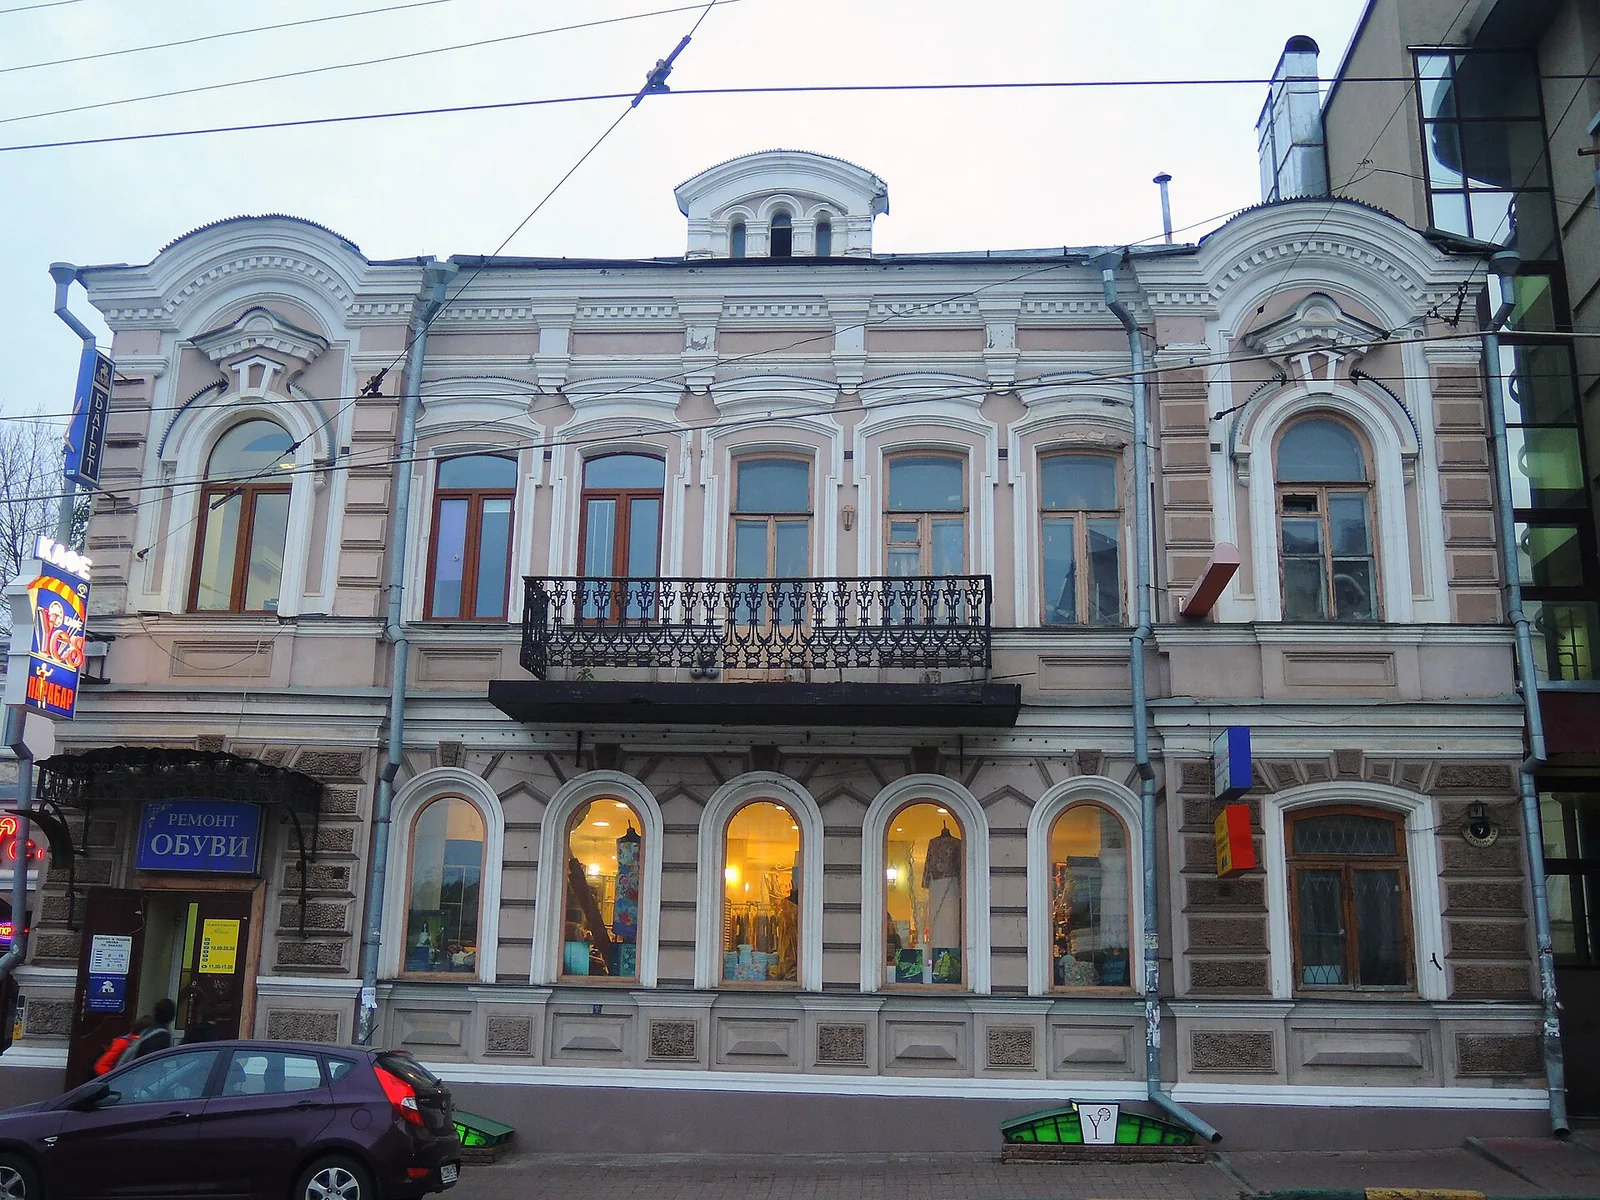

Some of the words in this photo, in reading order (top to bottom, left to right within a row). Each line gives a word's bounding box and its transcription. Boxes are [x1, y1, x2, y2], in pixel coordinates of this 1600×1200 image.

[86, 392, 103, 474] БАГЕТ
[38, 534, 93, 581] КАФЕ
[28, 675, 74, 710] ПАРАБАР
[168, 813, 239, 828] РЕМОНТ
[150, 833, 250, 857] ОБУВИ
